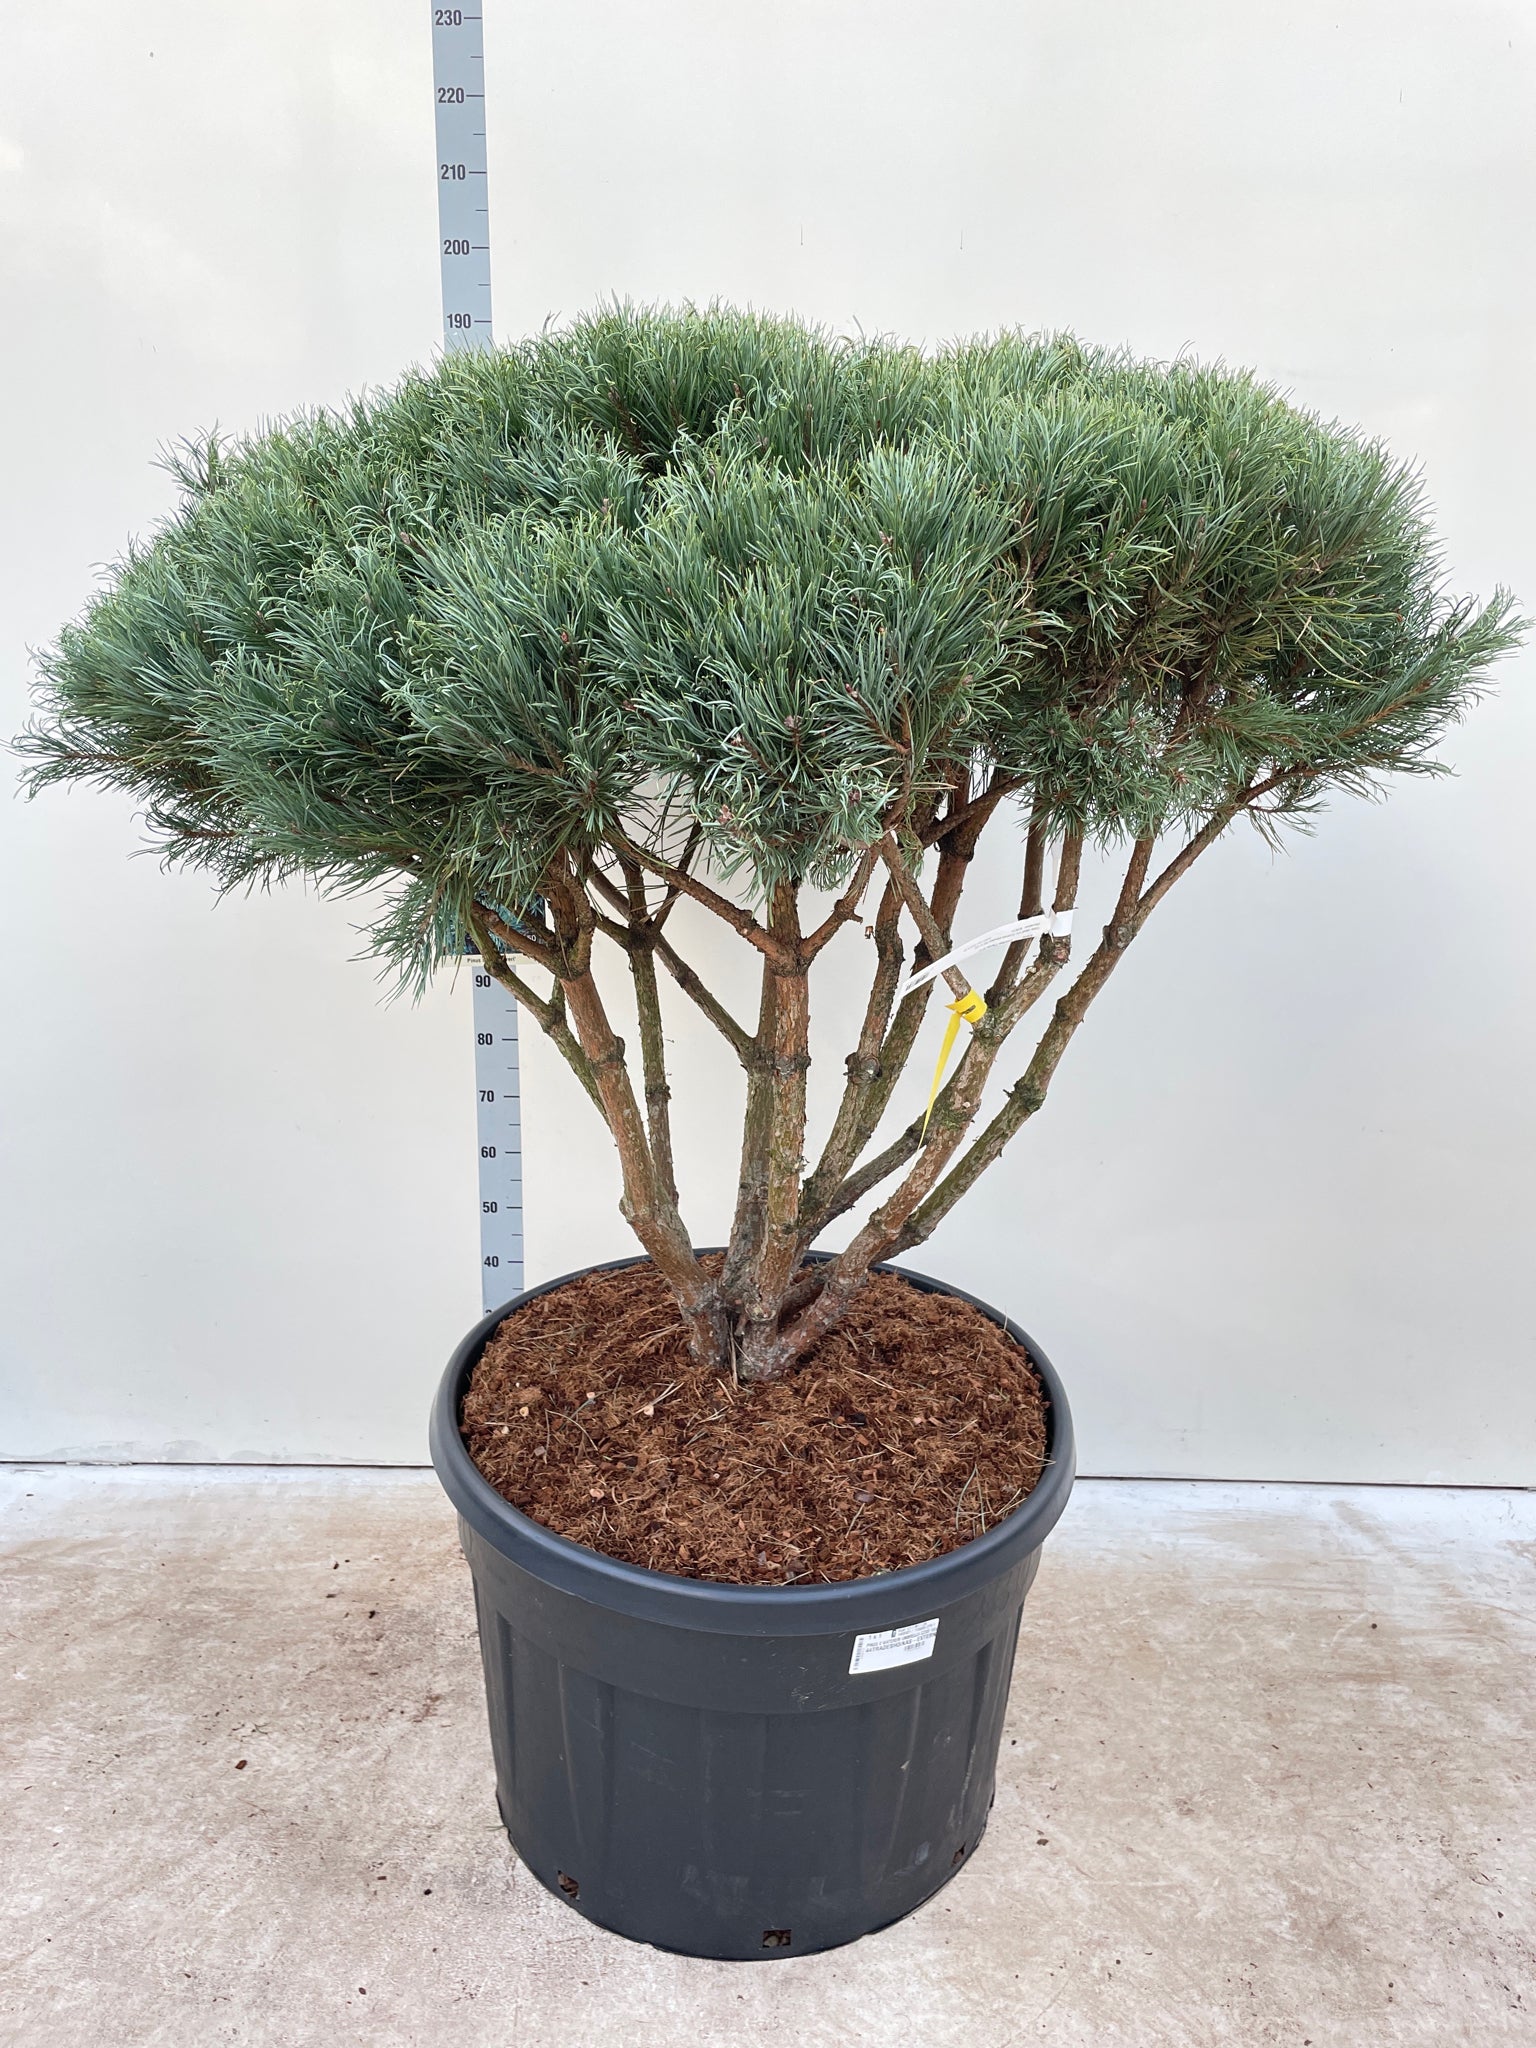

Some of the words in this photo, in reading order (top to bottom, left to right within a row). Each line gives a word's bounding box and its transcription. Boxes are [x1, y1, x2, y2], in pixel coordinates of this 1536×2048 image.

[435, 10, 462, 25] 230
[438, 88, 464, 103] 220
[441, 164, 466, 180] 210
[444, 240, 470, 255] 200
[447, 314, 472, 328] 190
[475, 975, 491, 988] 90
[477, 1033, 493, 1046] 80
[479, 1090, 495, 1102] 70
[481, 1146, 497, 1158] 60
[482, 1201, 498, 1213] 50
[484, 1256, 499, 1267] 40
